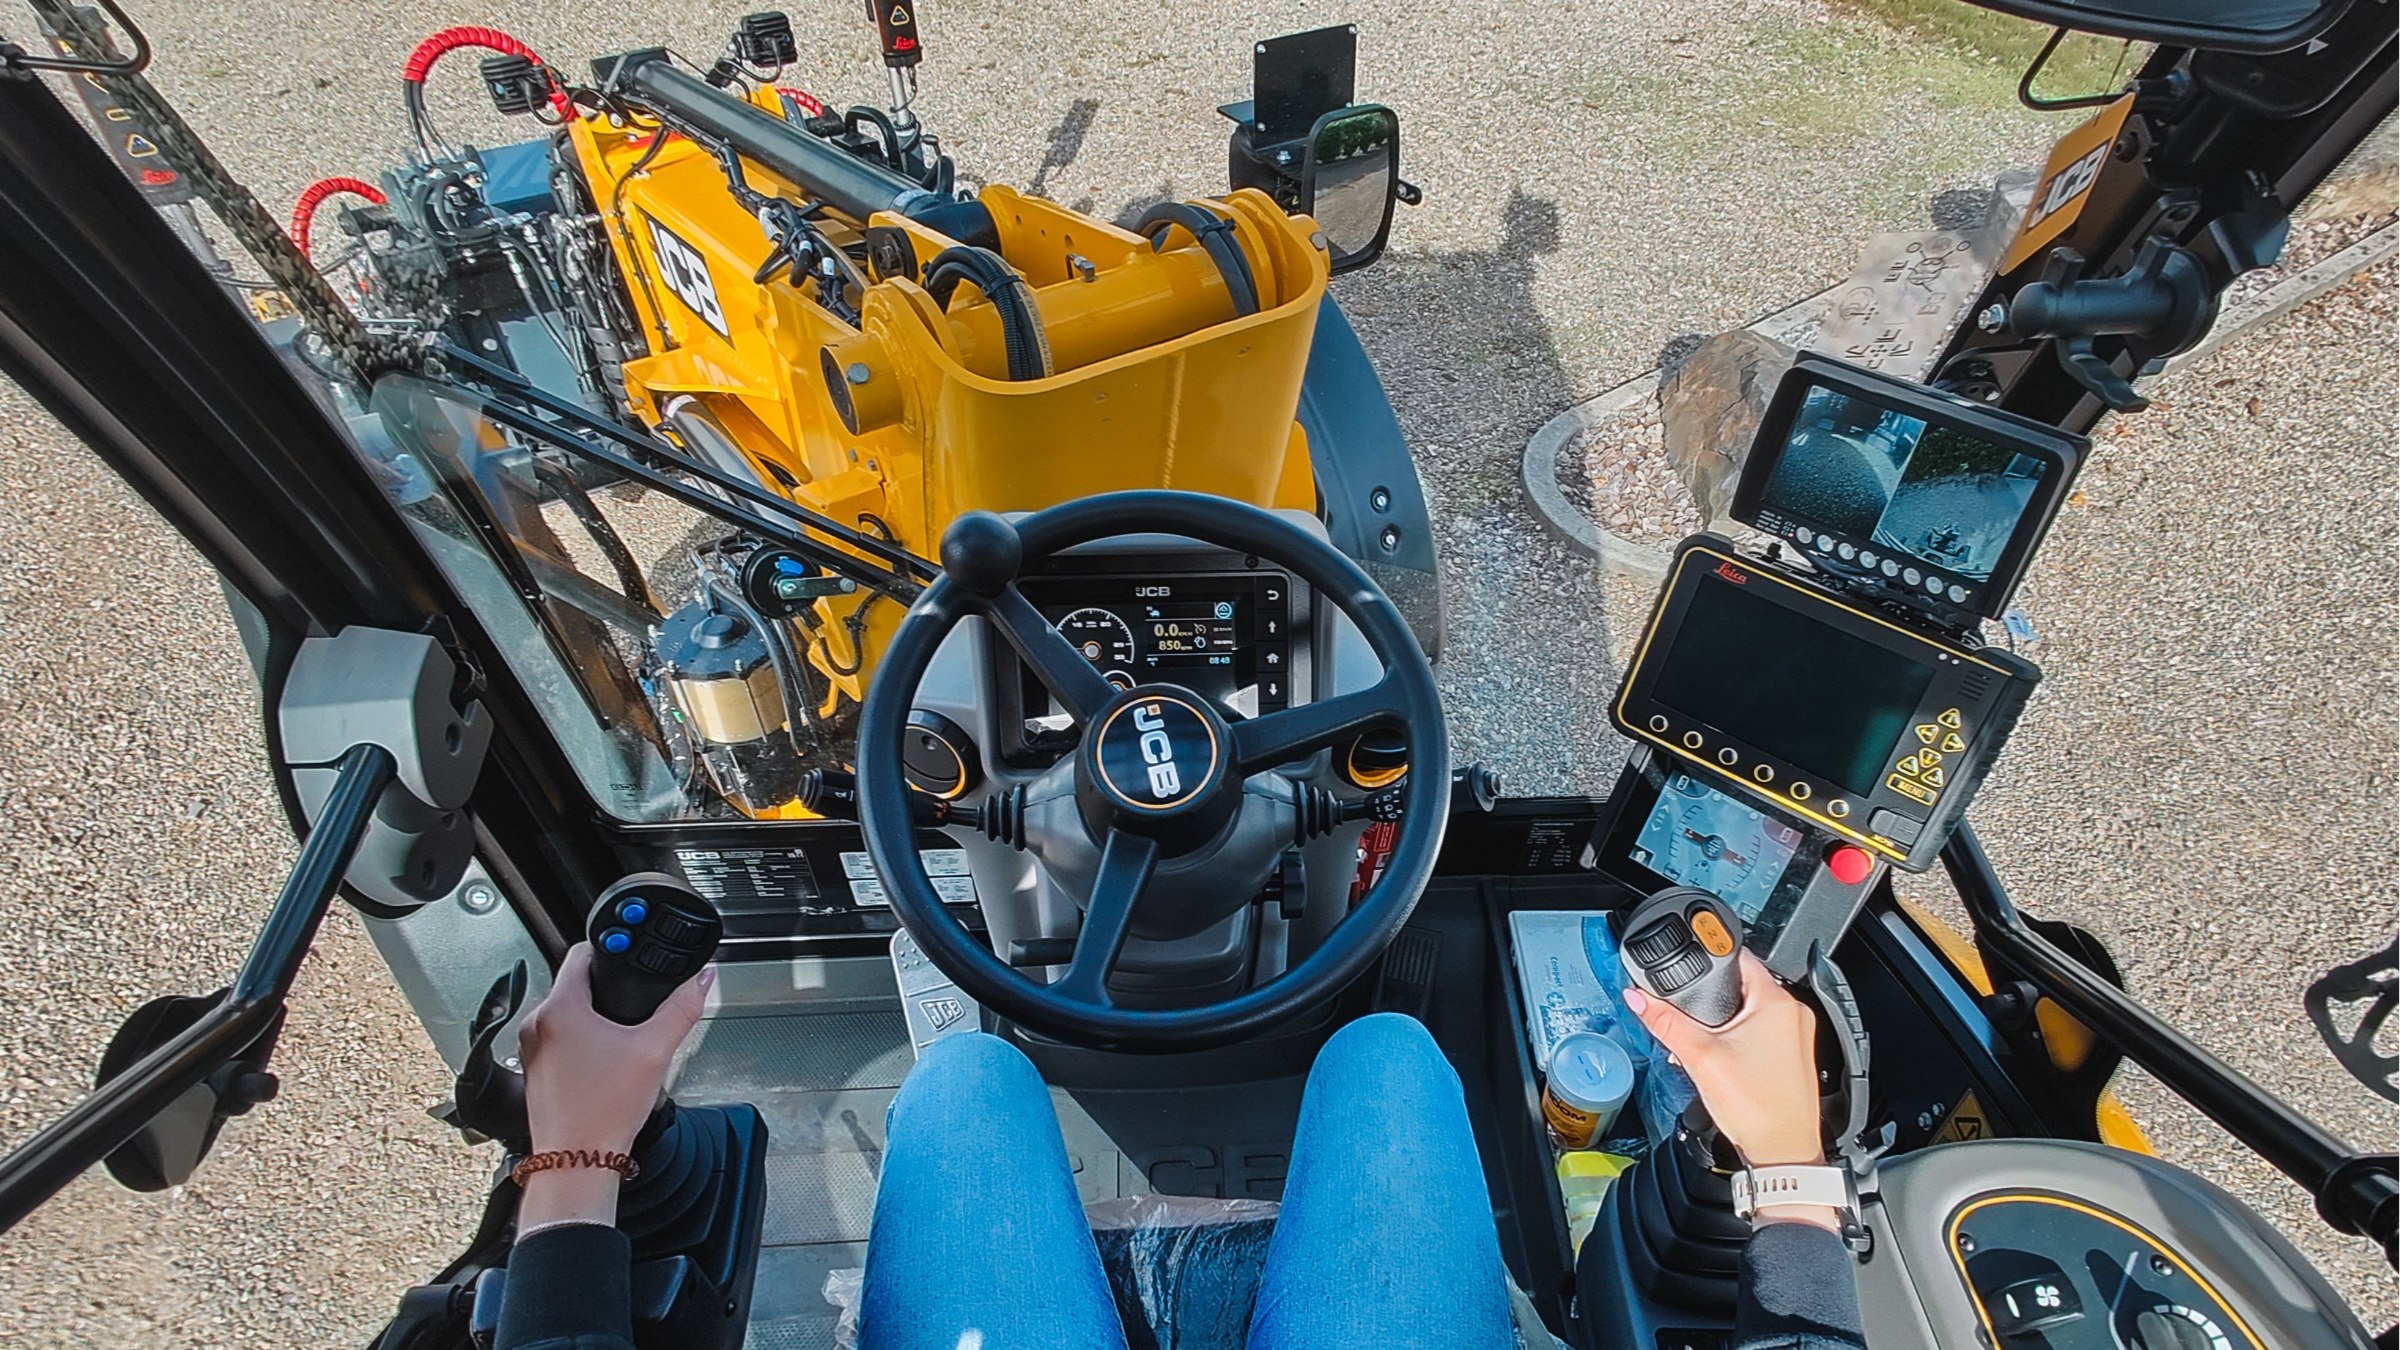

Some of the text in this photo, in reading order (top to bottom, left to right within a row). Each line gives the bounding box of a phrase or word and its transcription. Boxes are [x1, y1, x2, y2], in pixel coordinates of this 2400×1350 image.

[2028, 143, 2108, 229] JCB
[648, 219, 729, 337] JCB
[1713, 562, 1747, 585] Leica
[1136, 587, 1170, 597] JCB
[1154, 624, 1179, 637] 0.0
[1159, 640, 1181, 651] 850
[1133, 704, 1181, 798] JCB
[1897, 779, 1926, 799] MENU
[677, 852, 721, 860] JCB
[926, 1001, 961, 1026] JCB
